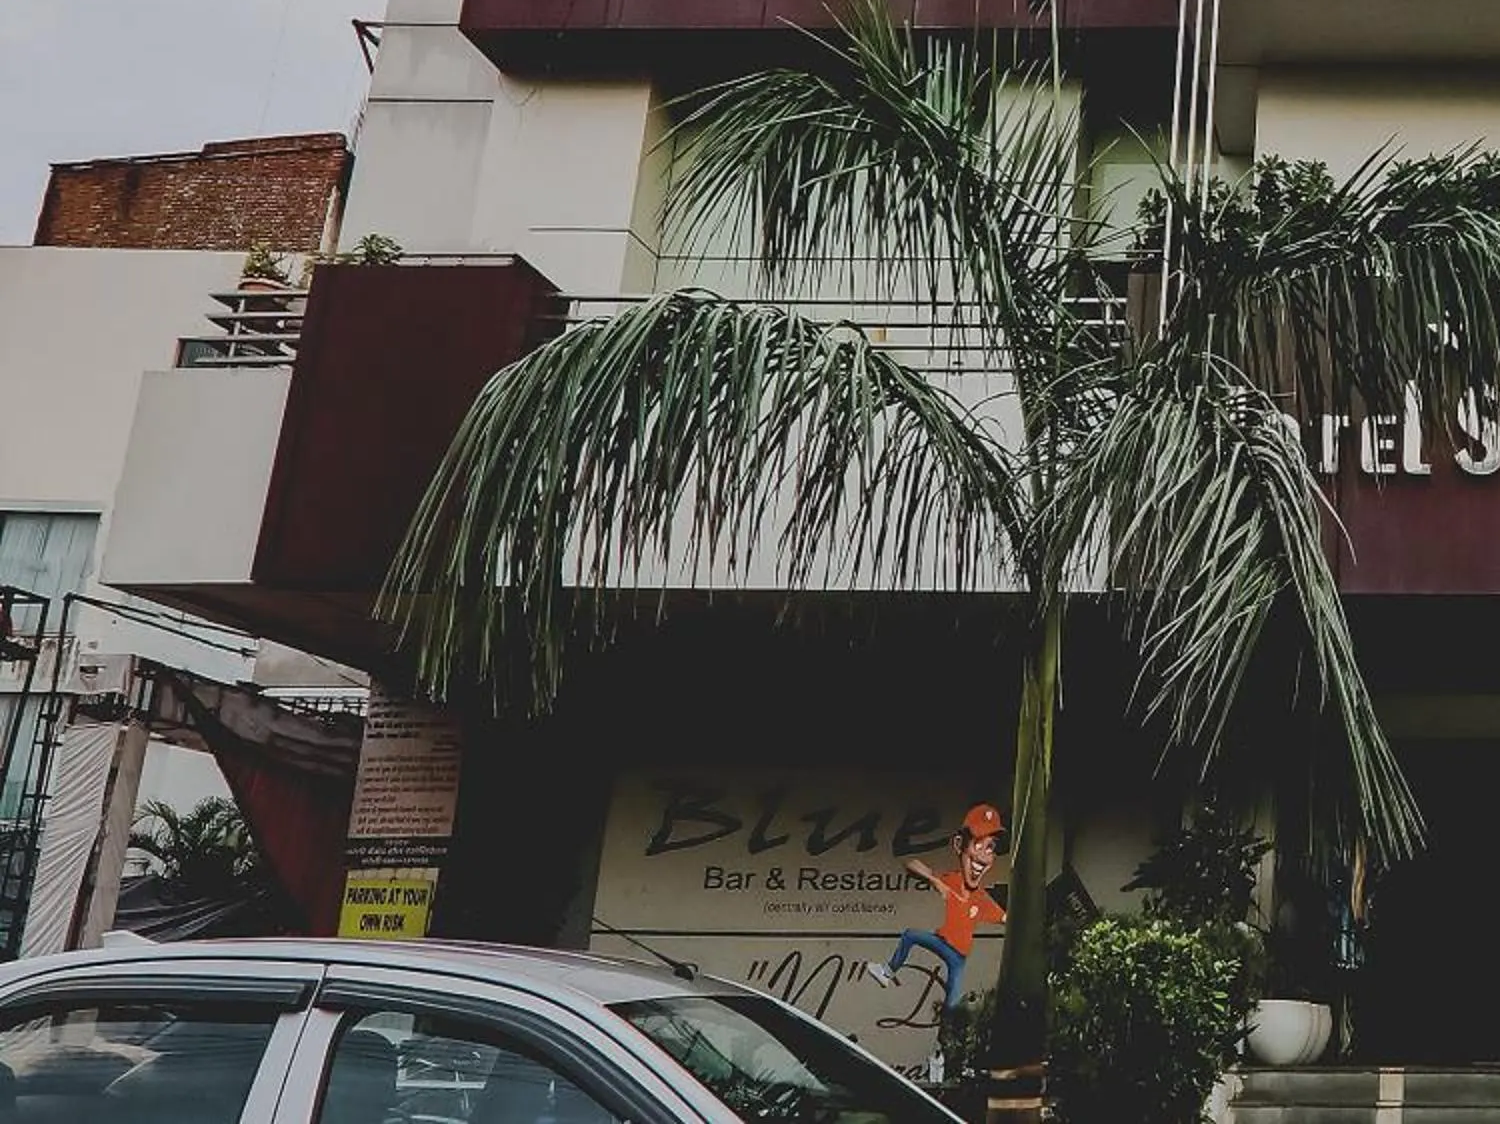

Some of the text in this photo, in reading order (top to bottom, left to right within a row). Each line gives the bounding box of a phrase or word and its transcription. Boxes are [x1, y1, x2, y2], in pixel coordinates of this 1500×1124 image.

[703, 867, 756, 890] Bar
[765, 867, 786, 891] &
[346, 887, 428, 906] PARKING AT YOUR
[359, 913, 406, 931] OWN RISK
